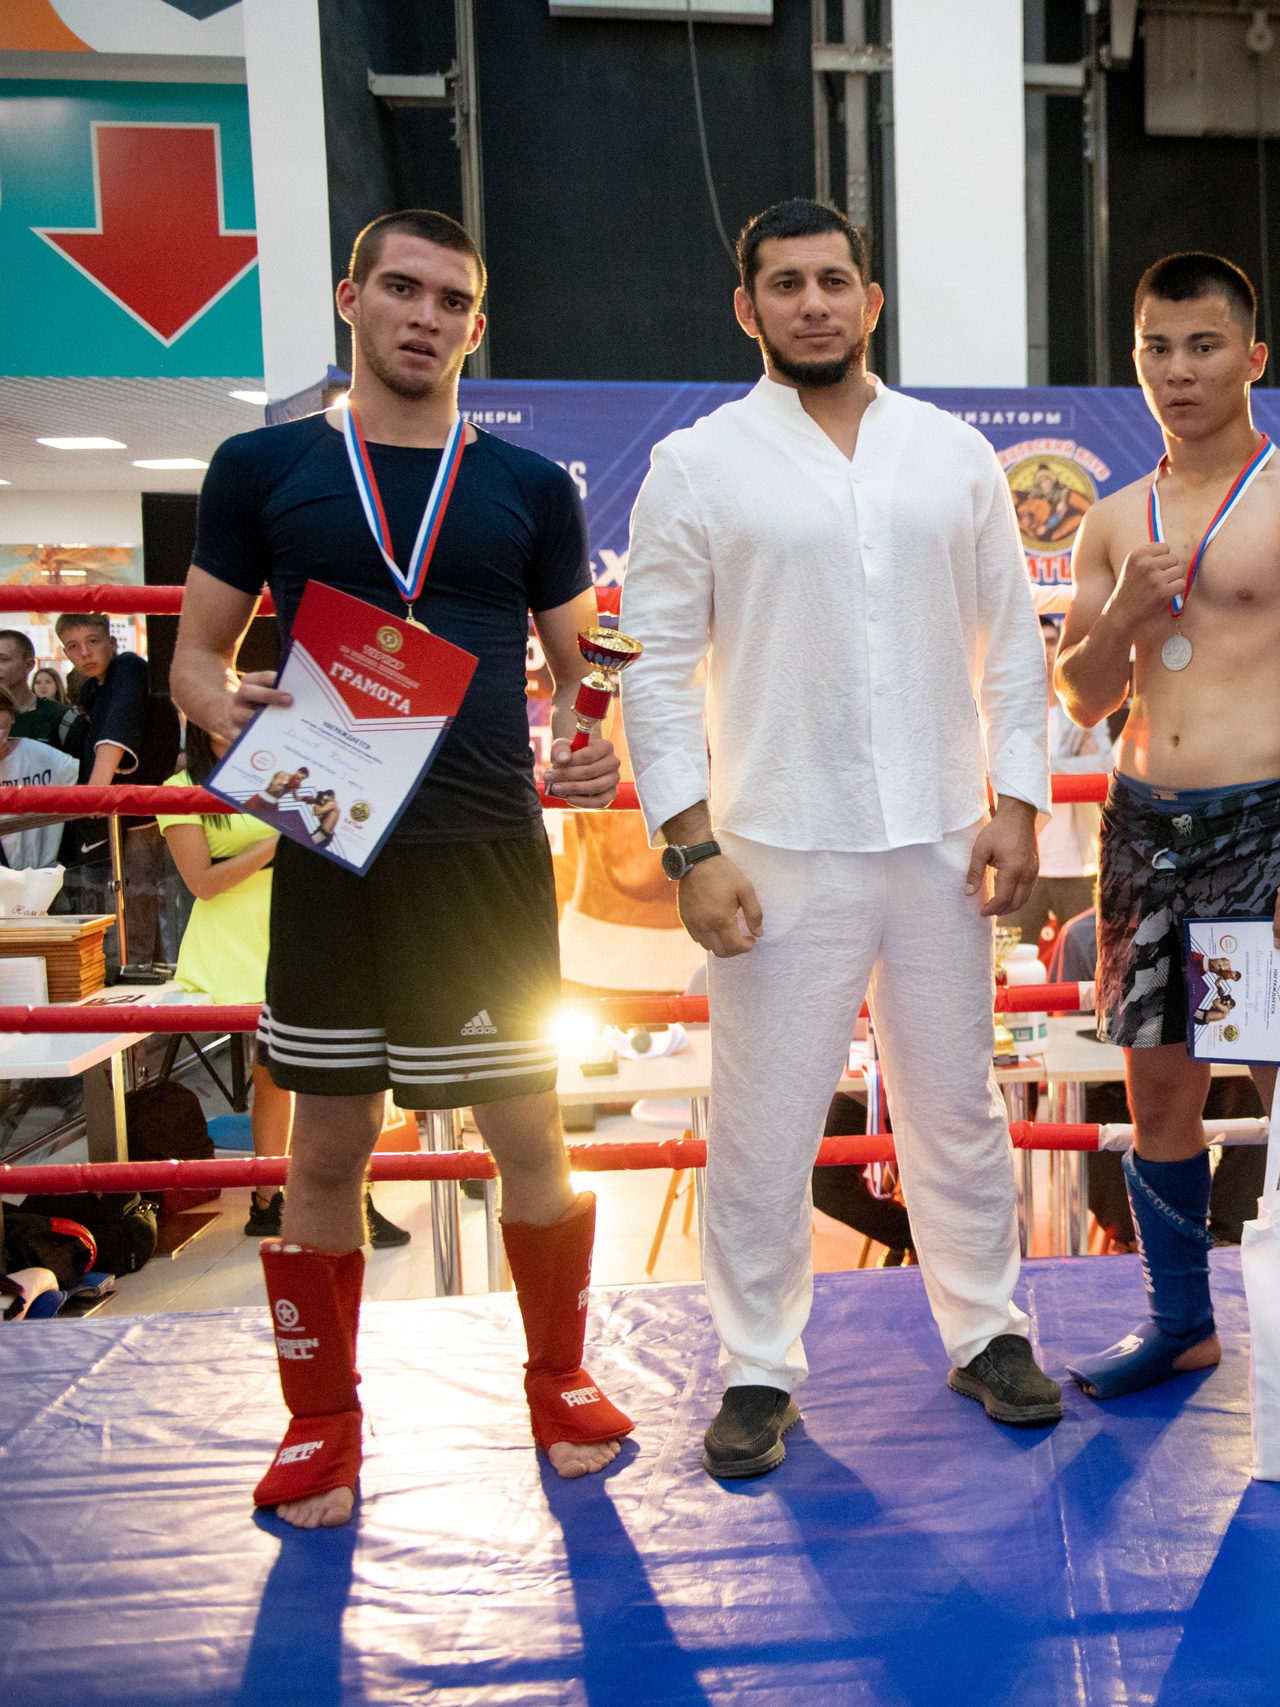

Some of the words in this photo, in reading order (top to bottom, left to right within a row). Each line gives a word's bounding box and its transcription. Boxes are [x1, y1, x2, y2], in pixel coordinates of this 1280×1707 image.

[329, 661, 411, 715] ГРАМОТА
[461, 1026, 498, 1036] adidas
[1138, 1177, 1186, 1226] VENUM
[561, 1386, 598, 1400] GREEN
[565, 1393, 600, 1407] HILL
[280, 1440, 324, 1456] GREEN
[275, 1449, 315, 1466] HILL
